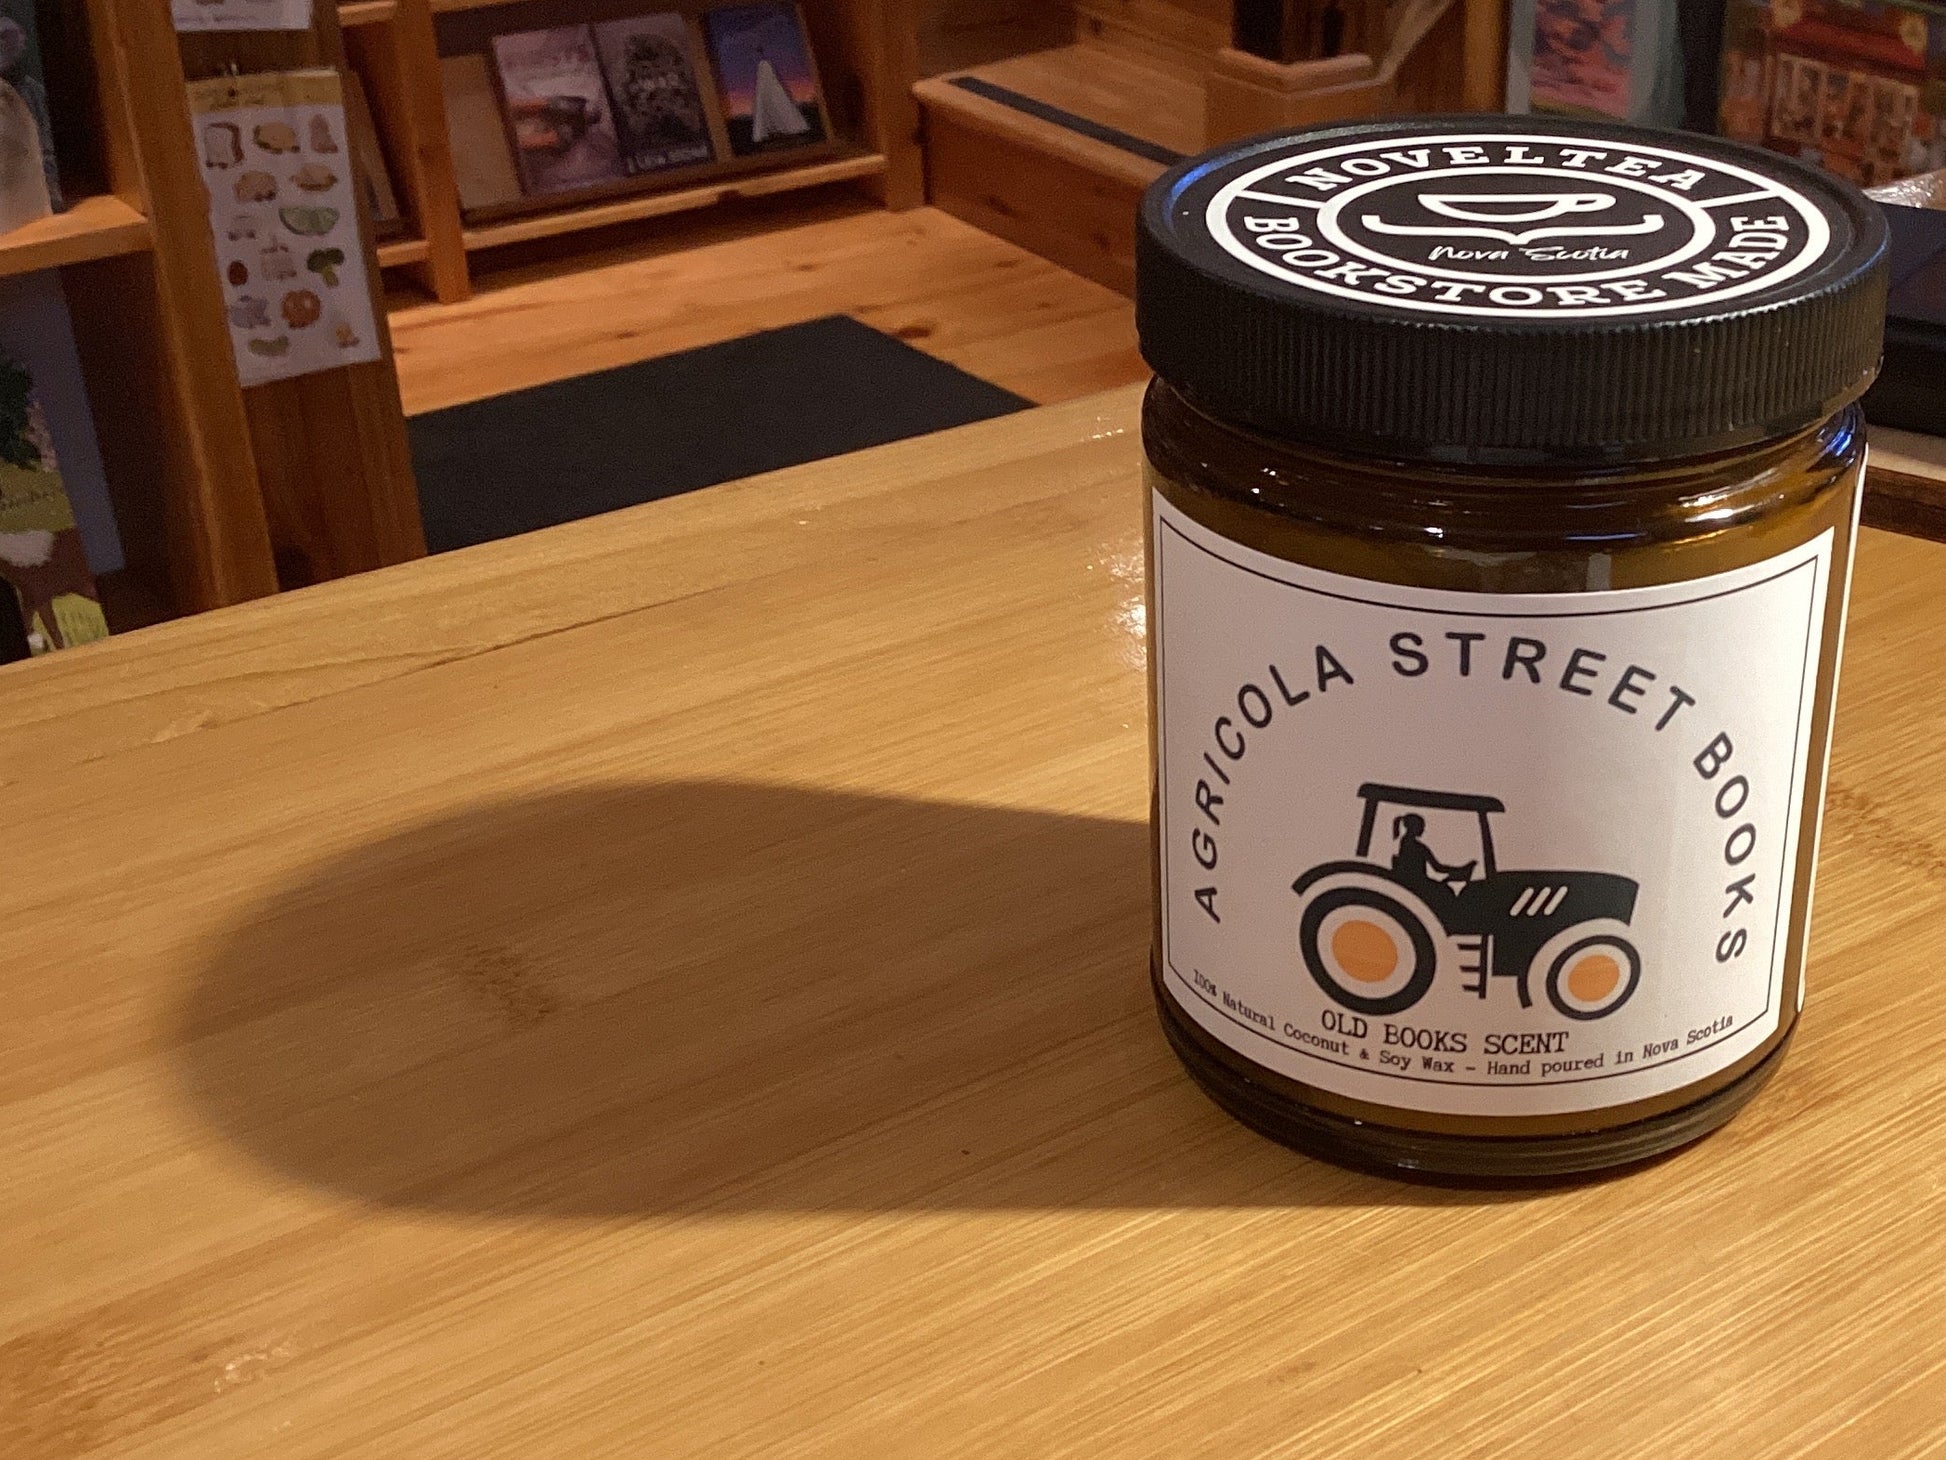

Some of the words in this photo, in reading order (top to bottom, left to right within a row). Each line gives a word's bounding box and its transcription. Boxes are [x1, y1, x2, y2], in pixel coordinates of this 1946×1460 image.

[1286, 146, 1706, 193] NOVELTEA
[1244, 214, 1669, 307] BOOKSTORE
[1662, 214, 1790, 290] MADE
[1427, 244, 1509, 262] Nova
[1518, 246, 1631, 263] Scotia
[1191, 644, 1355, 924] AGRICOLA
[1389, 631, 1697, 732] STREET
[1692, 731, 1757, 964] BOOKS
[1193, 969, 1217, 997] 100%
[1222, 991, 1276, 1032] Natural
[1283, 1023, 1350, 1055] Coconut
[1359, 1048, 1370, 1060] &
[1379, 1051, 1411, 1070] Soy
[1422, 1055, 1454, 1073] Wax
[1487, 1060, 1530, 1075] Hand
[1541, 1054, 1604, 1077] poured
[1616, 1051, 1633, 1066] in
[1642, 1038, 1679, 1060] Nova
[1686, 1014, 1734, 1046] Scotia
[1321, 1009, 1368, 1039] OLD
[1383, 1023, 1468, 1053] BOOKS
[1483, 1031, 1569, 1055] SCENT
